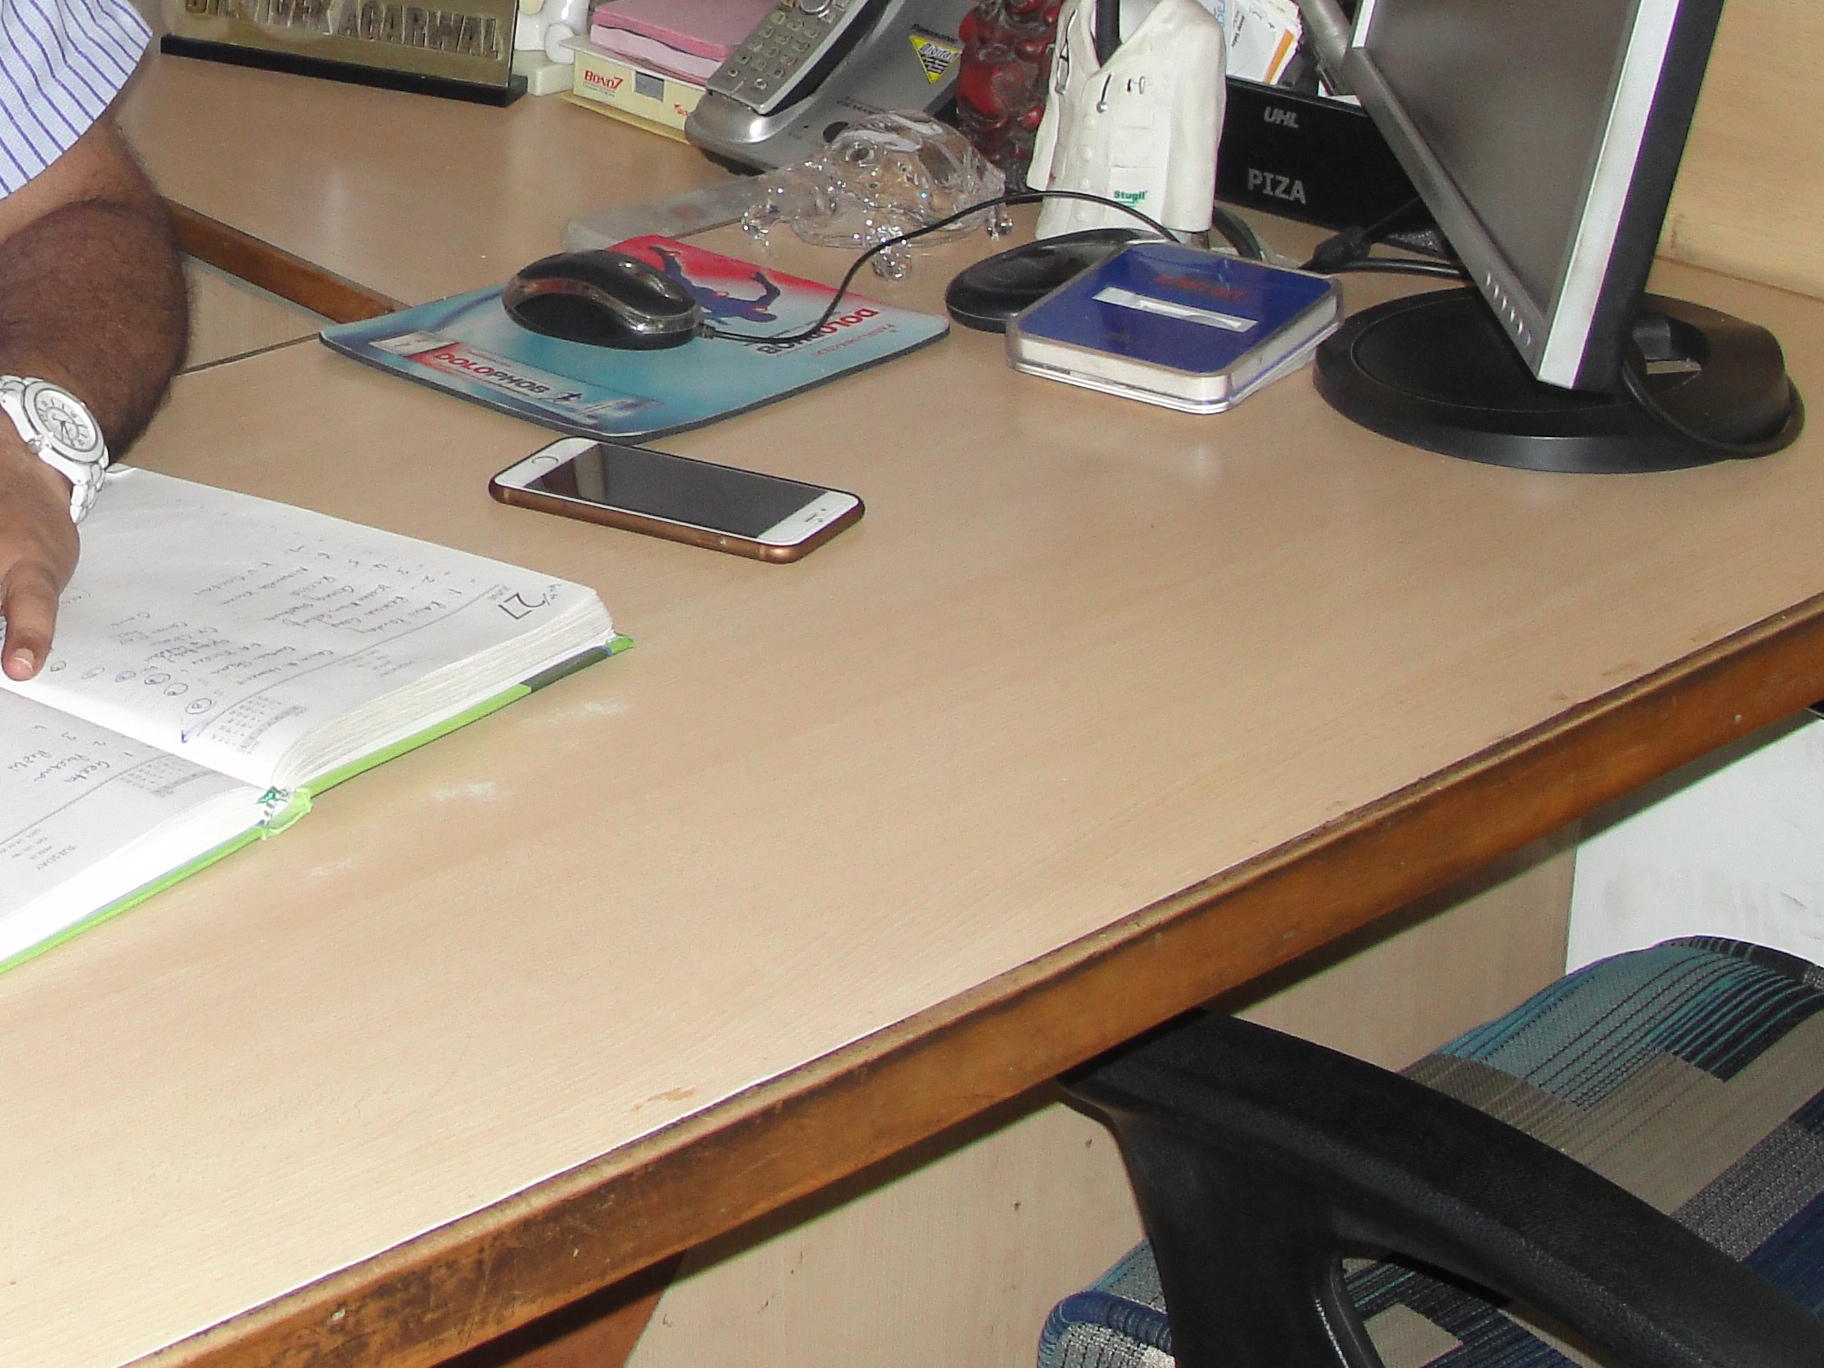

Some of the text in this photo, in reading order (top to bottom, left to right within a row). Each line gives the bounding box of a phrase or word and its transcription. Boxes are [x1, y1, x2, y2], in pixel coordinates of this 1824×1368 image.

[1263, 106, 1300, 129] UHL
[1113, 189, 1147, 202] Stugil
[1247, 167, 1307, 205] PIZA
[497, 592, 547, 620] 27
